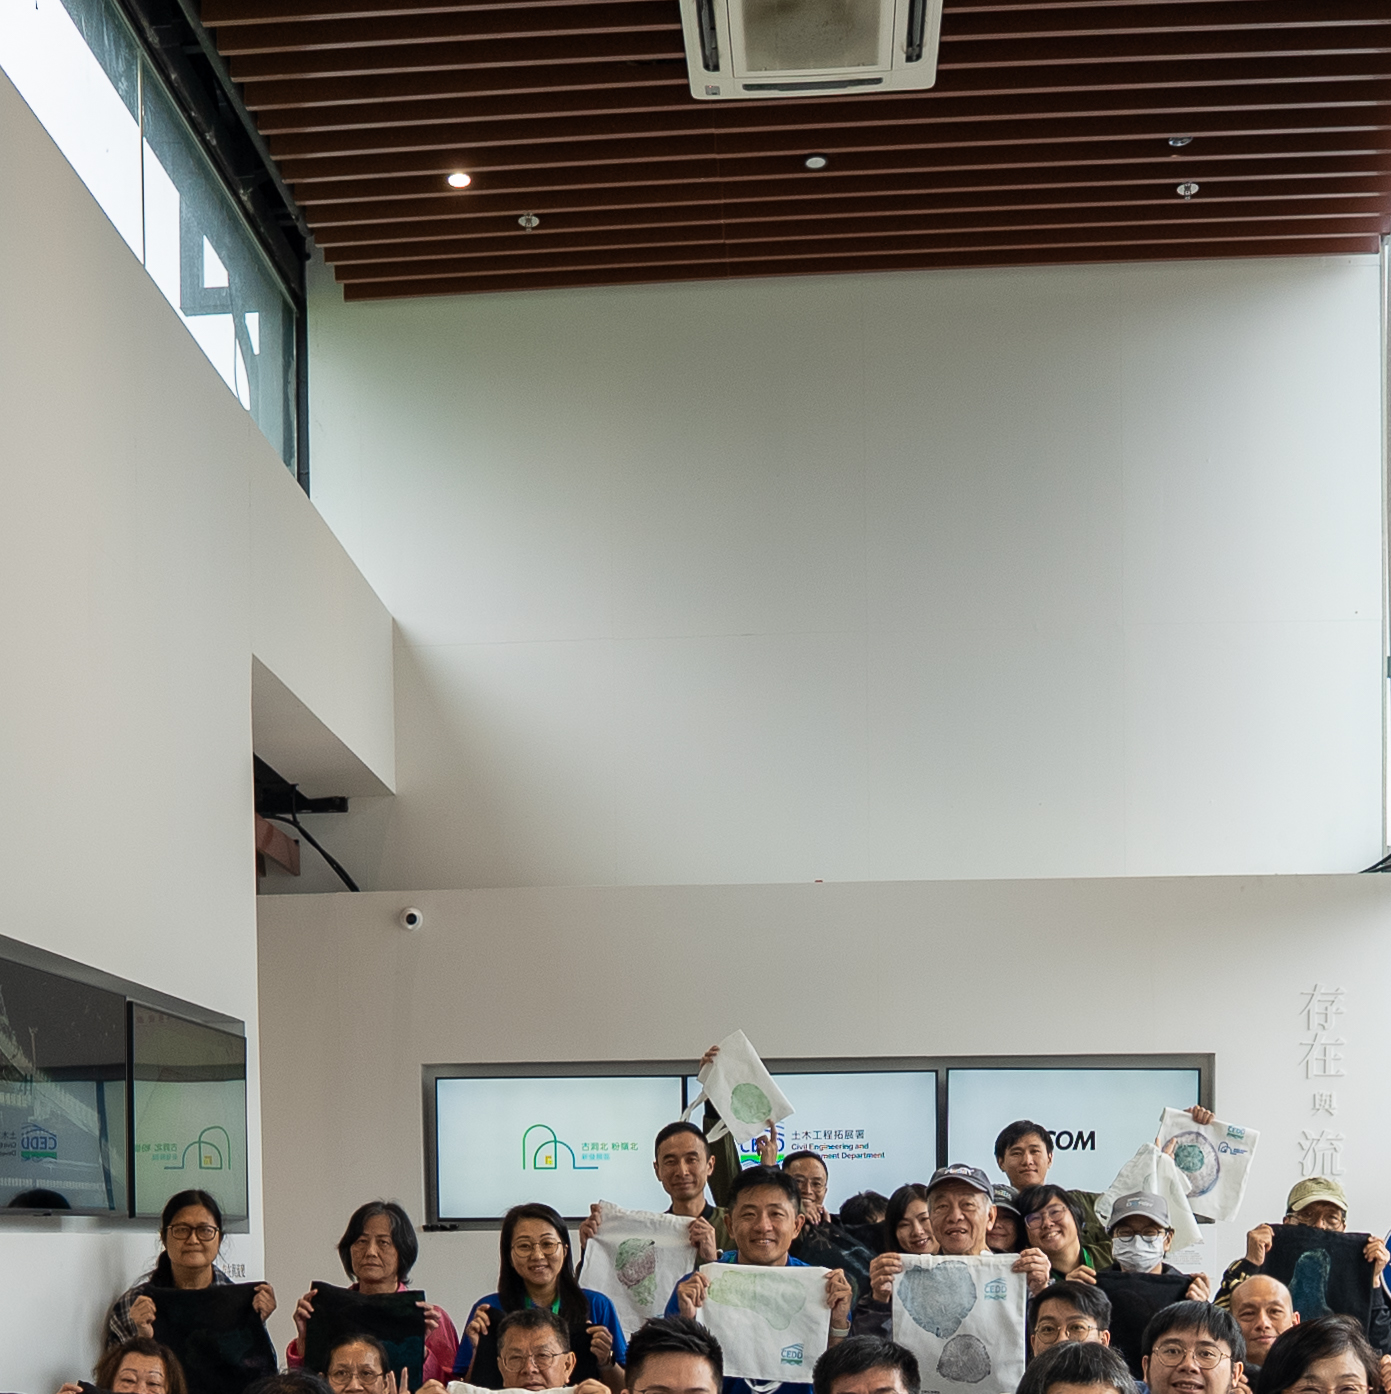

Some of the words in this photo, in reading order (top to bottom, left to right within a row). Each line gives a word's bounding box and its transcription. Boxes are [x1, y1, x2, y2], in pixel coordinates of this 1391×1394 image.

[791, 1129, 865, 1140] 土木工程拓展署
